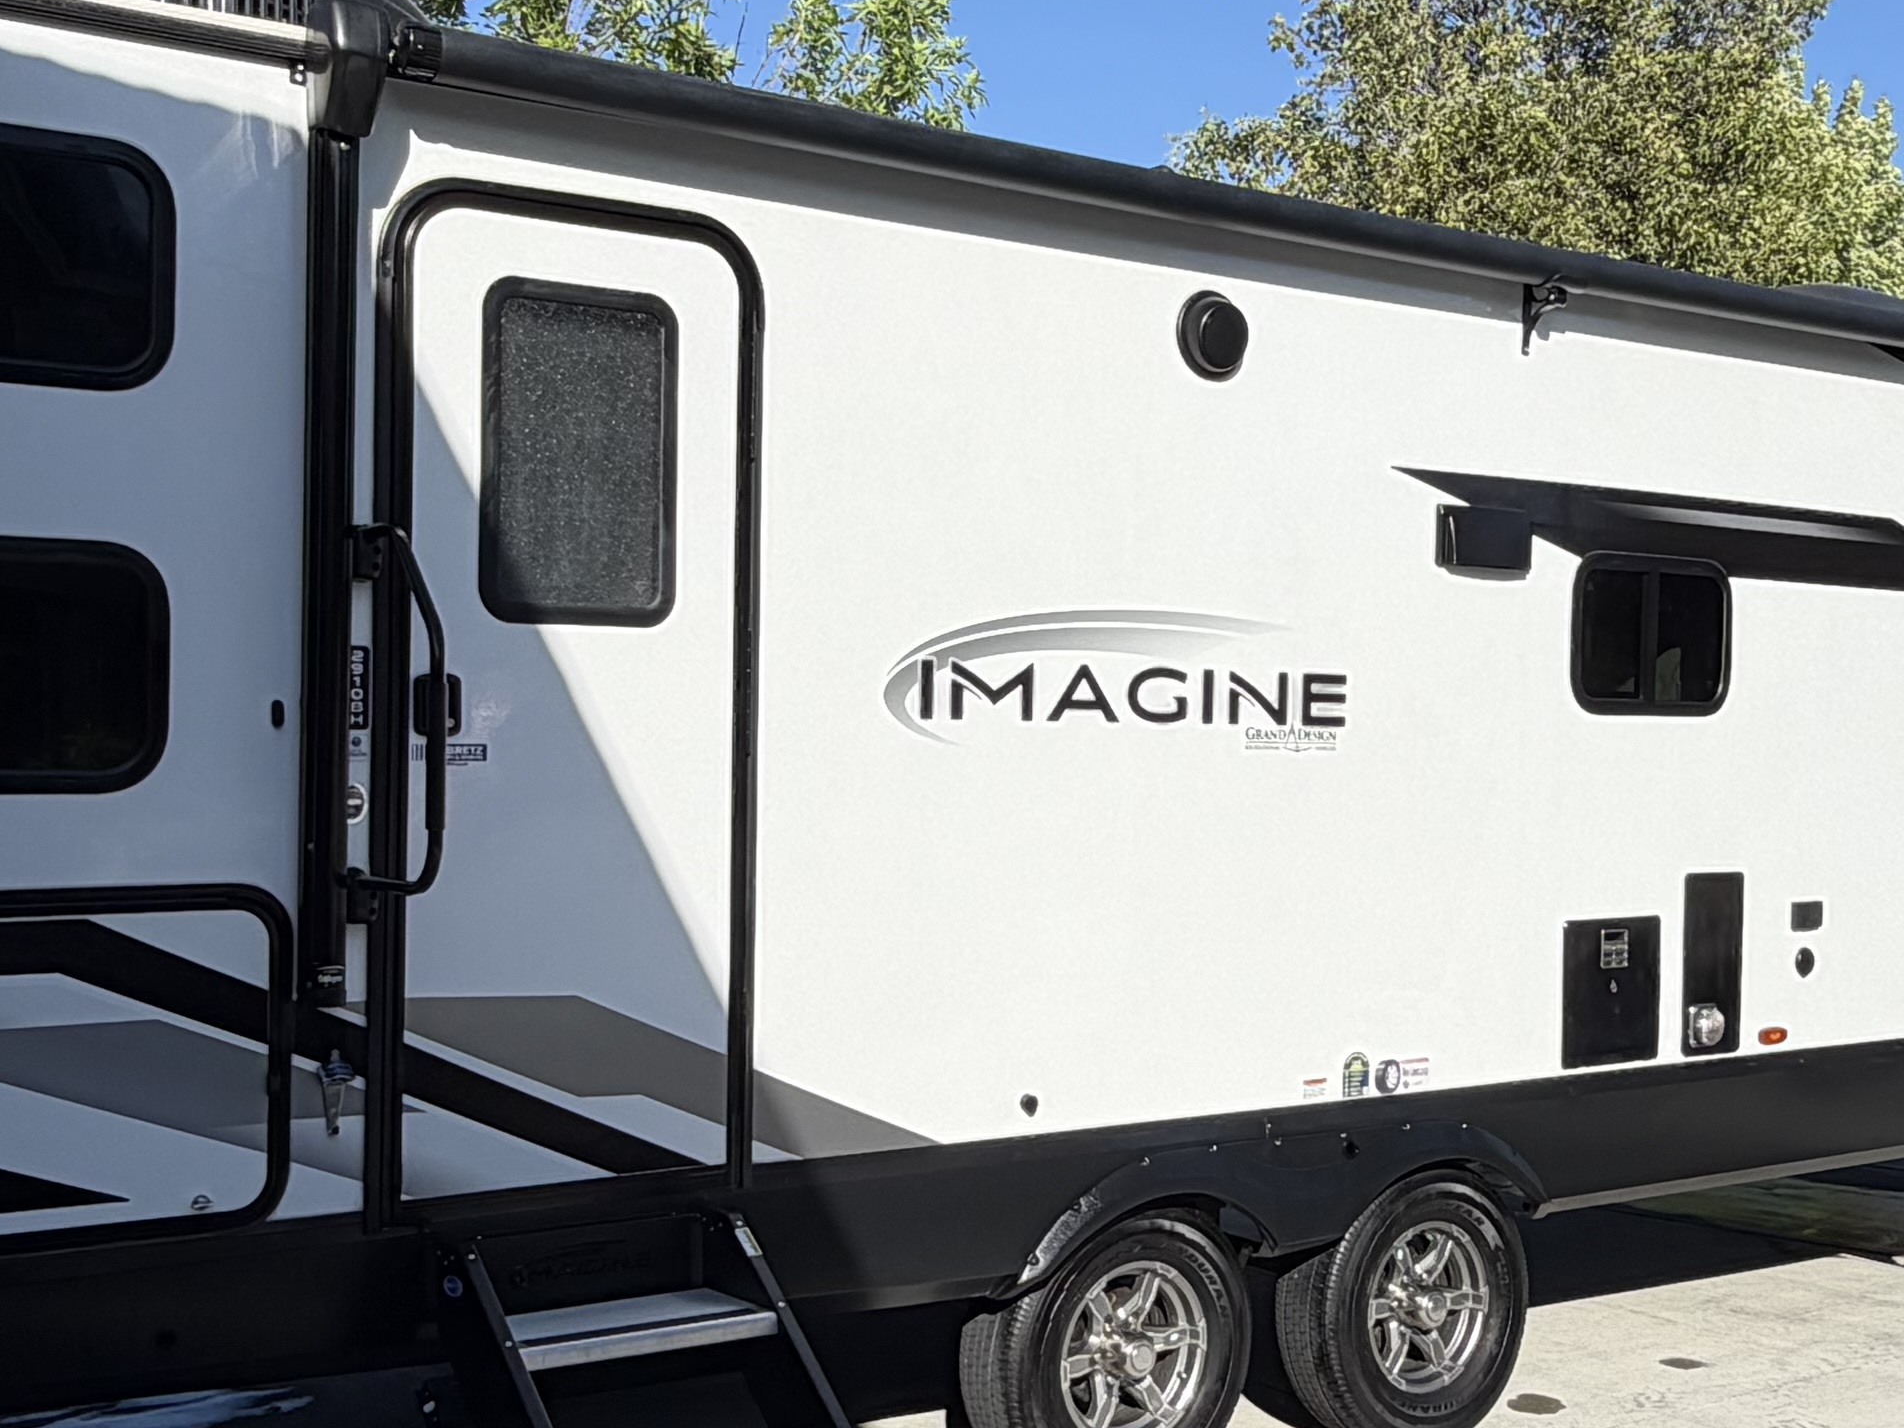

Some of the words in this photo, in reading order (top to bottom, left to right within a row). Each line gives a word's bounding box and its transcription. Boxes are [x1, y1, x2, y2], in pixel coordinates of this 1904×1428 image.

[920, 657, 1348, 728] IMAGINE
[1245, 726, 1287, 741] GRAND
[1297, 727, 1337, 742] DESIGN
